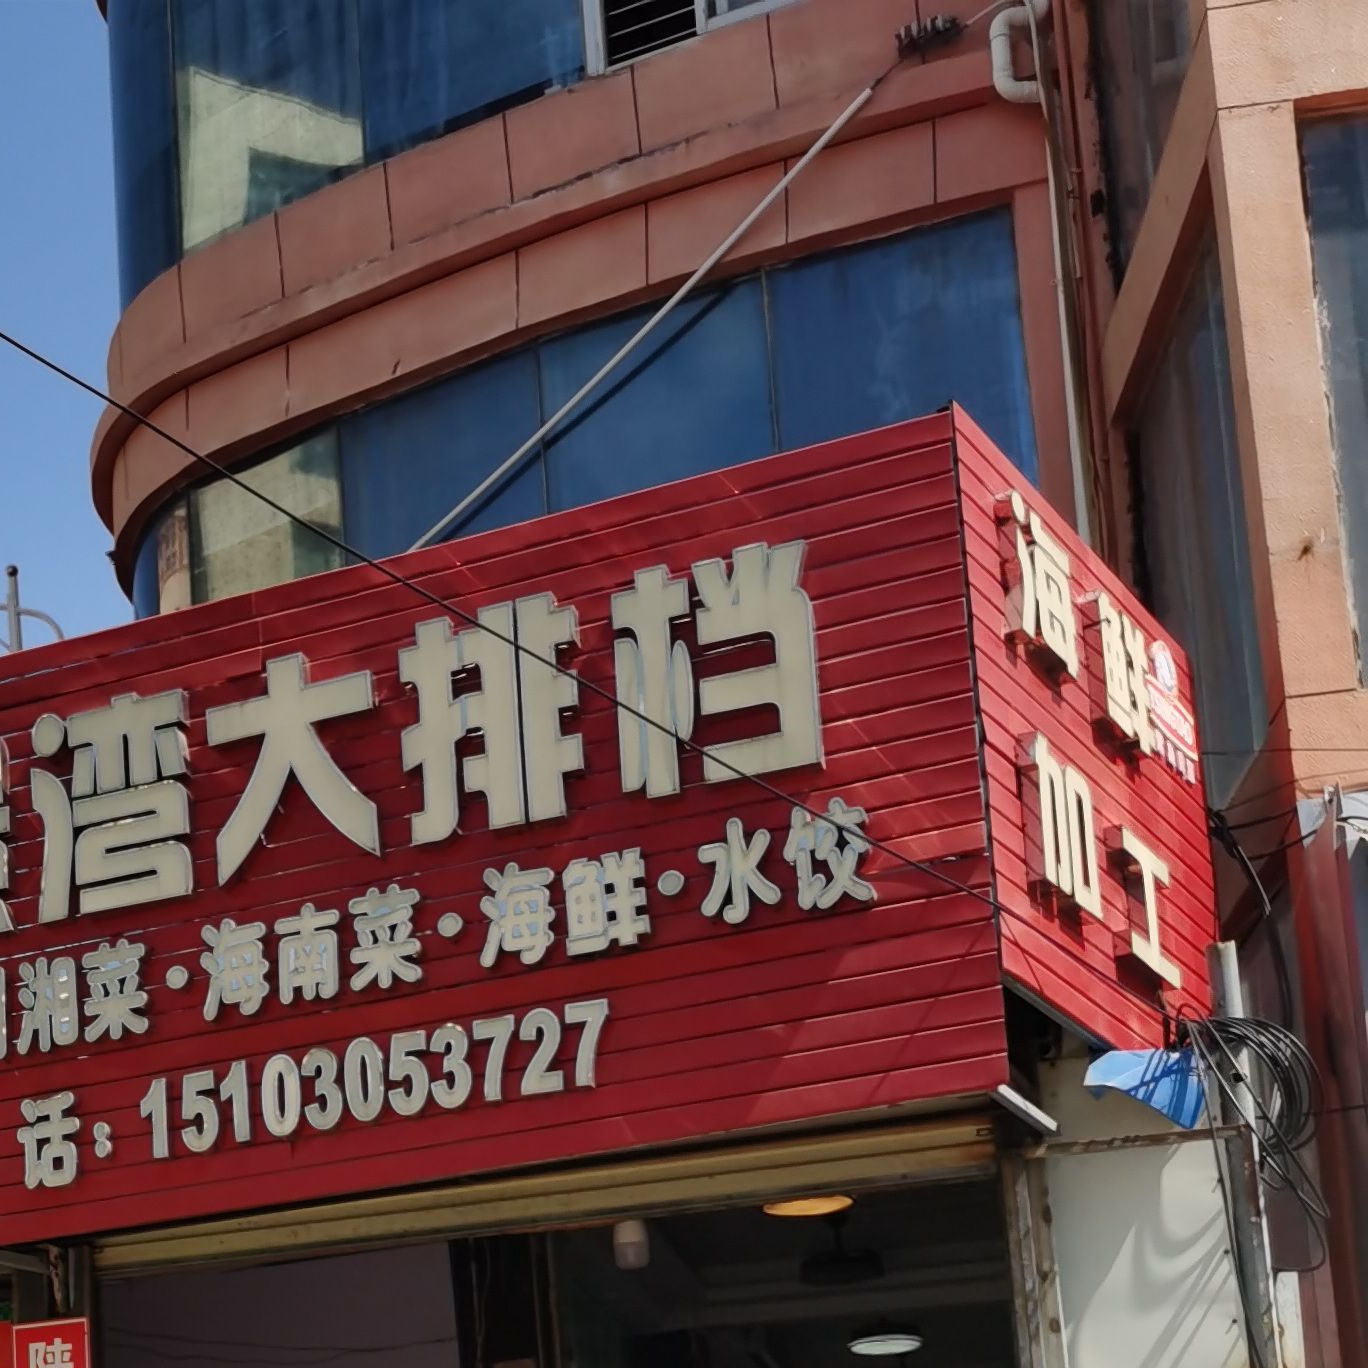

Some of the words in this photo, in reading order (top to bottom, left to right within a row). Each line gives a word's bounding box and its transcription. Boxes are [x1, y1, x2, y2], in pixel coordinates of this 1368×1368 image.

[1012, 488, 1156, 757] 海鲜
[1033, 732, 1182, 990] 加工
[140, 999, 609, 1159] 15103053727
